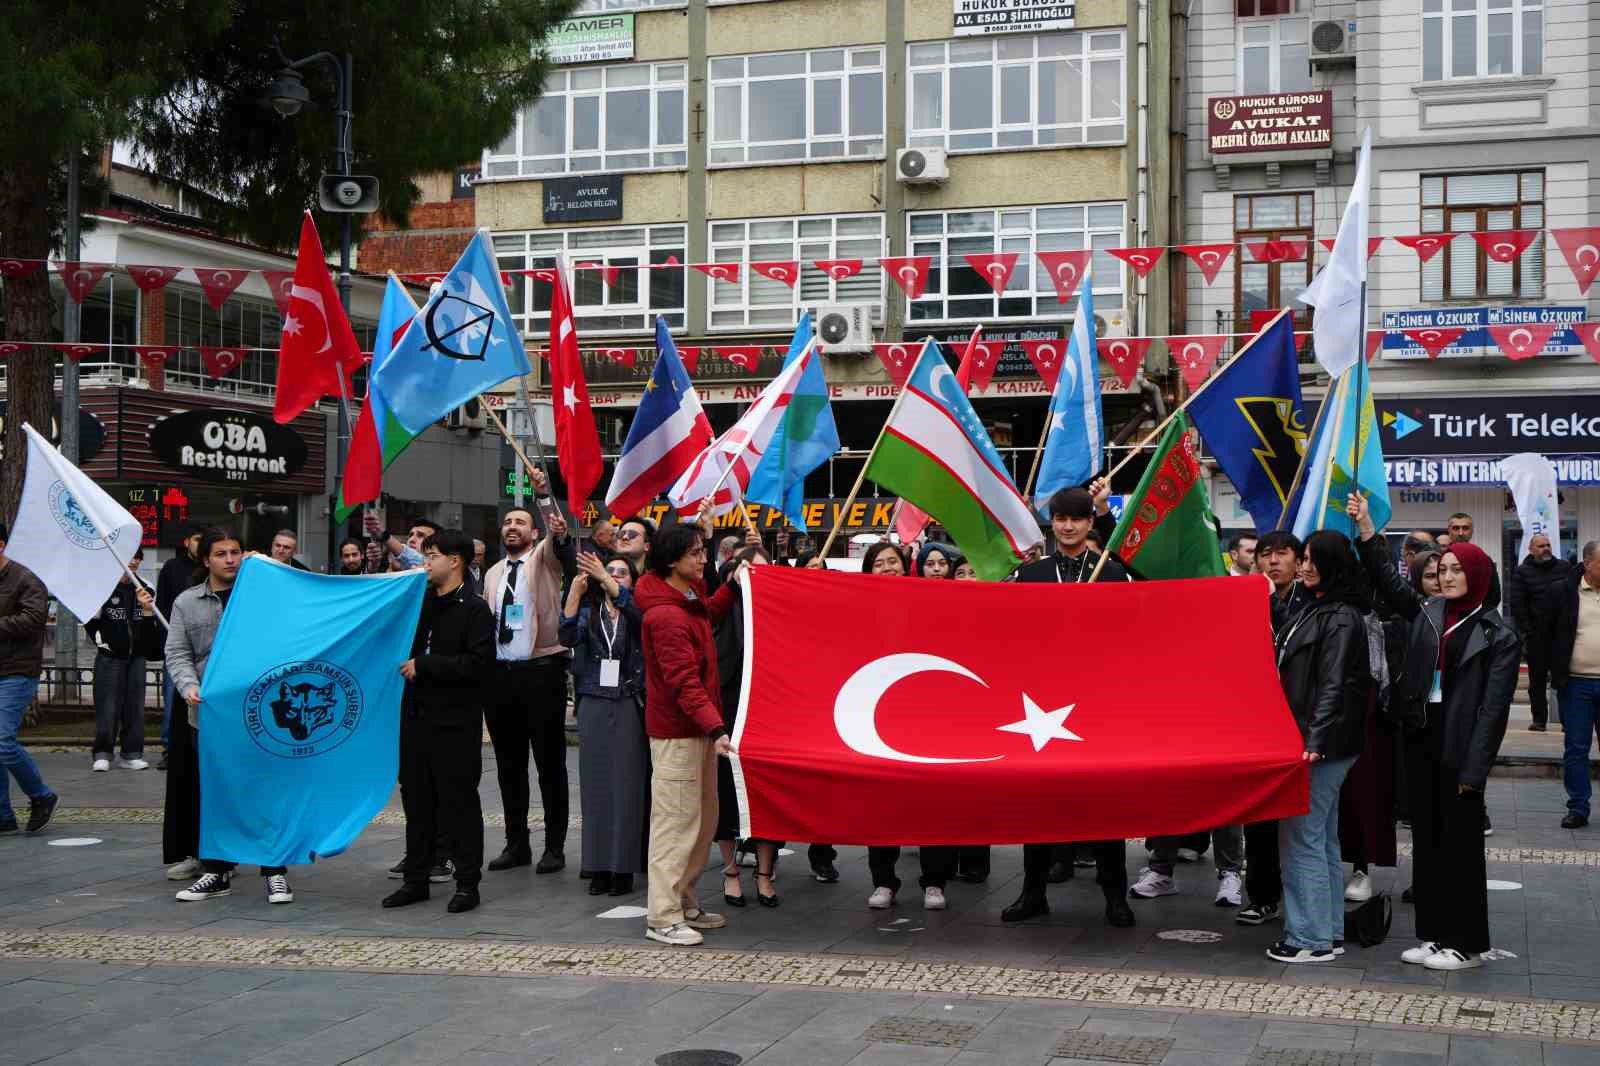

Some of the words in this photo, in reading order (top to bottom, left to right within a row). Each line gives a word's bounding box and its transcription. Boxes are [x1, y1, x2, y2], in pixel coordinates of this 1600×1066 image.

[956, 16, 973, 25] AV.
[977, 13, 1007, 24] ESAD
[1010, 7, 1072, 24] ŞİRİNOĞLU
[1239, 97, 1276, 108] HUKUK
[1278, 94, 1323, 106] BÜROSU
[1251, 106, 1303, 116] ARABULUCU
[1229, 115, 1321, 130] AVUKAT
[1211, 132, 1248, 148] MEHRİ
[1250, 130, 1288, 146] ÖZLEM
[1290, 129, 1331, 144] AKALIN
[576, 187, 609, 197] AVUKAT
[1400, 313, 1433, 327] SİNEM
[1436, 311, 1480, 325] ÖZKURT
[1503, 310, 1537, 323] SİNEM
[1540, 308, 1584, 322] ÖZKURT
[1428, 413, 1496, 438] Türk
[181, 445, 287, 474] Restaurant
[225, 470, 248, 481] 1971
[1395, 459, 1438, 486] EV-İŞ
[1441, 458, 1507, 483] İNTERN
[1400, 489, 1446, 503] tivibu
[304, 661, 354, 690] SAMSUN
